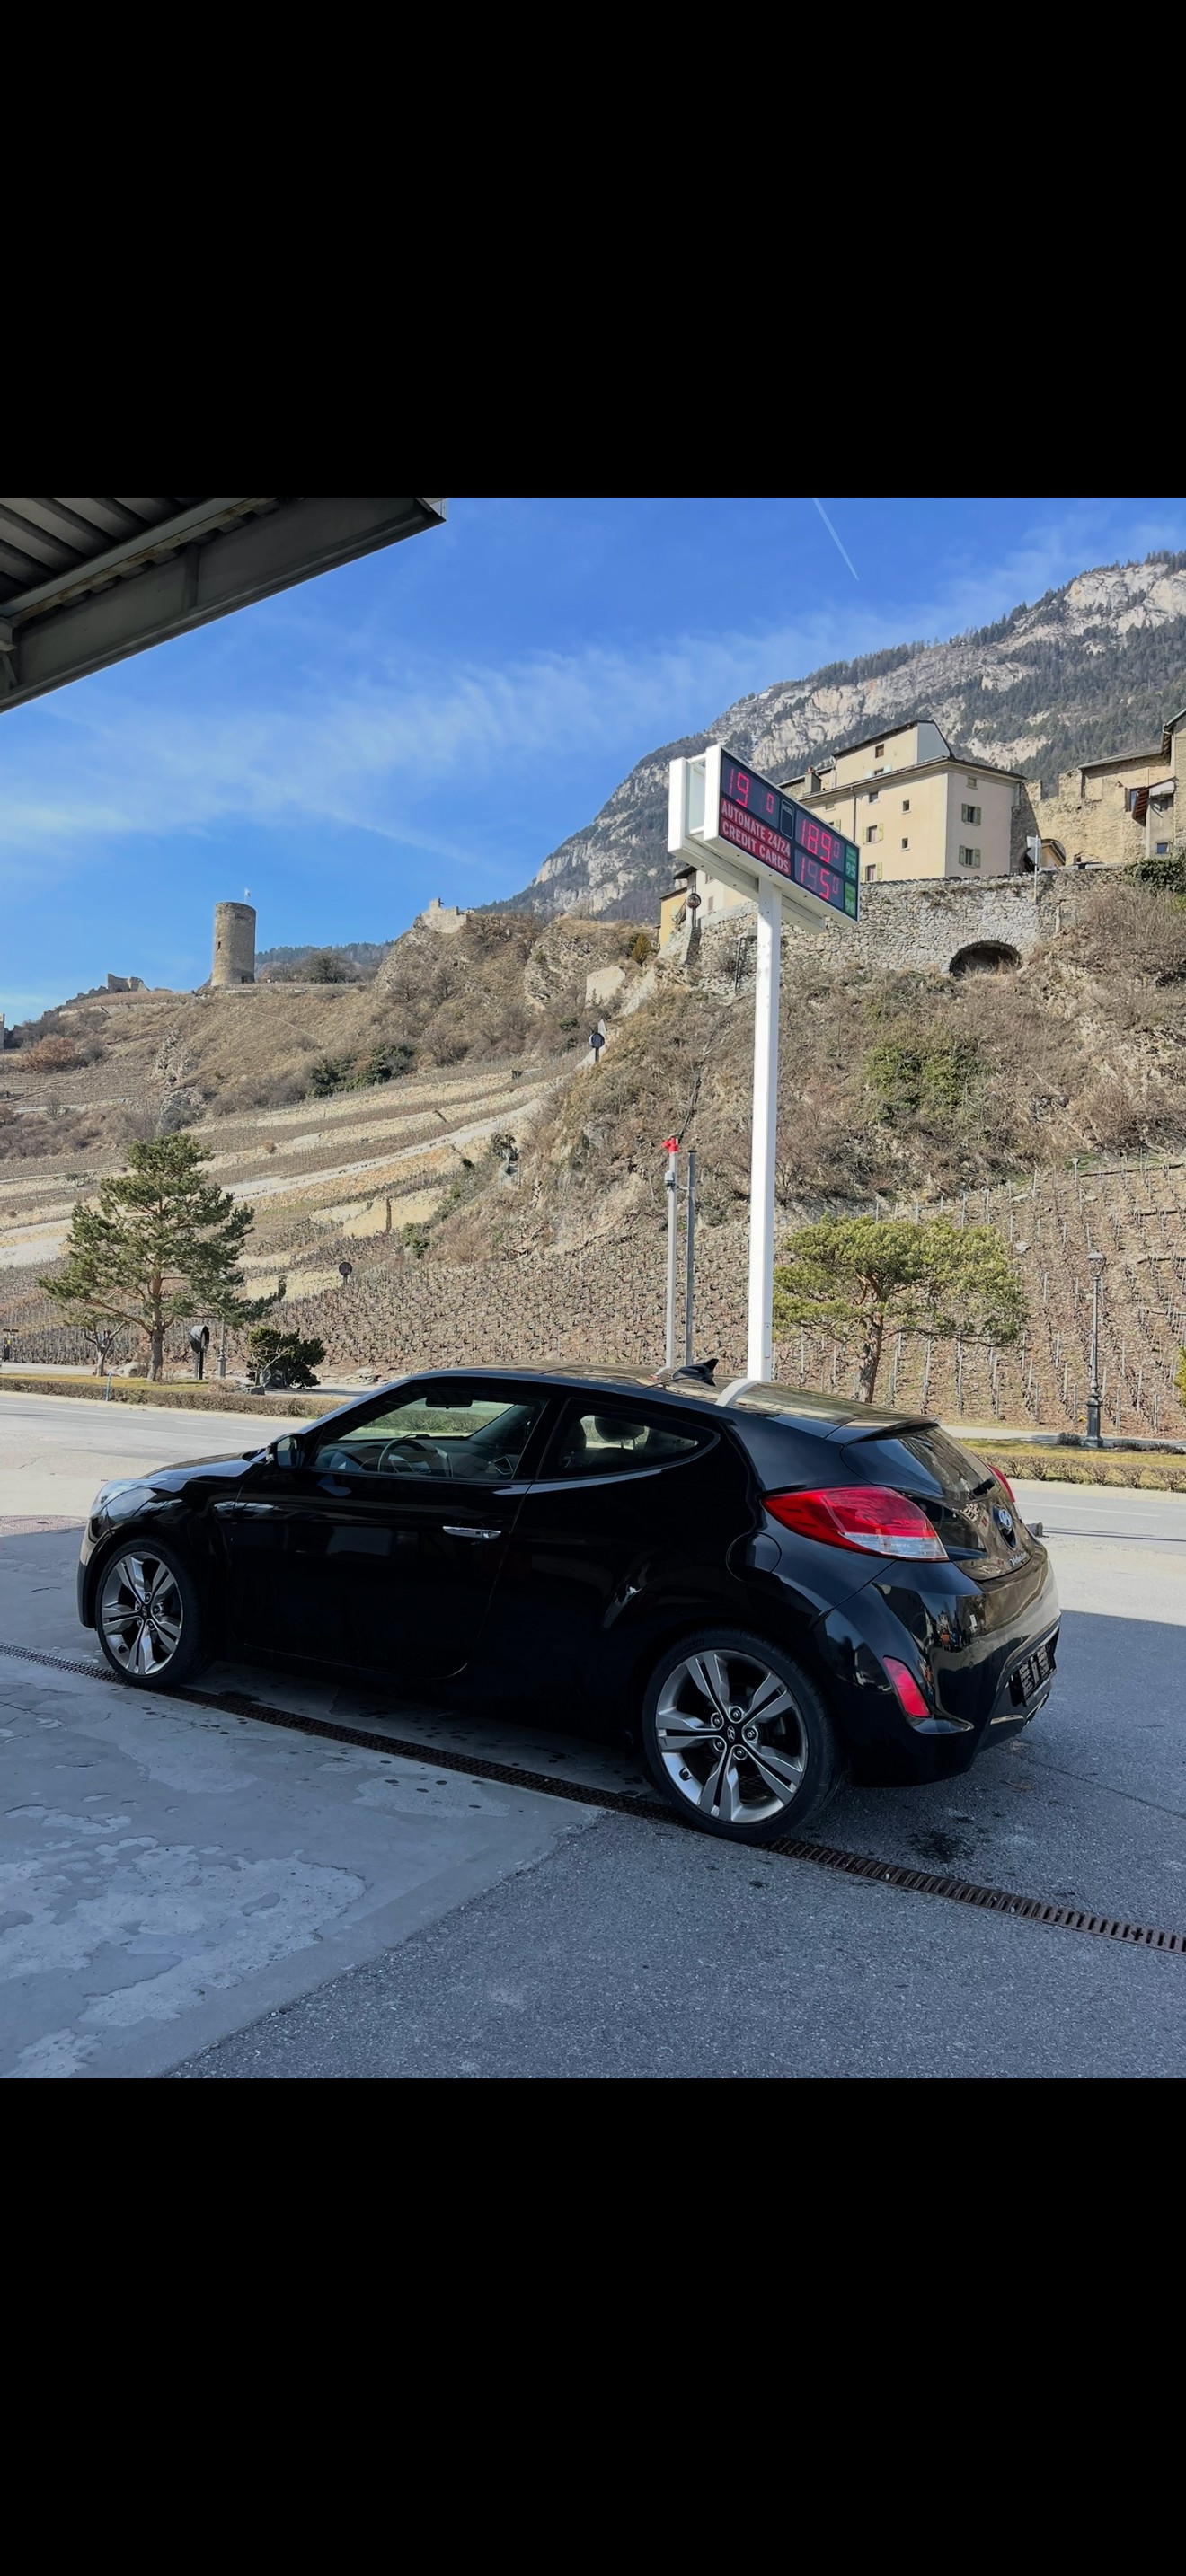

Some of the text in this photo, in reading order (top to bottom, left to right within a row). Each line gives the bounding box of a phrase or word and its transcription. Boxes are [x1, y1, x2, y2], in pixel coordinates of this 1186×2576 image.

[721, 800, 791, 857] AUTOMATE 24/24
[722, 821, 789, 873] CREDIT CARDS
[845, 861, 856, 879] 95
[845, 898, 855, 914] 98
